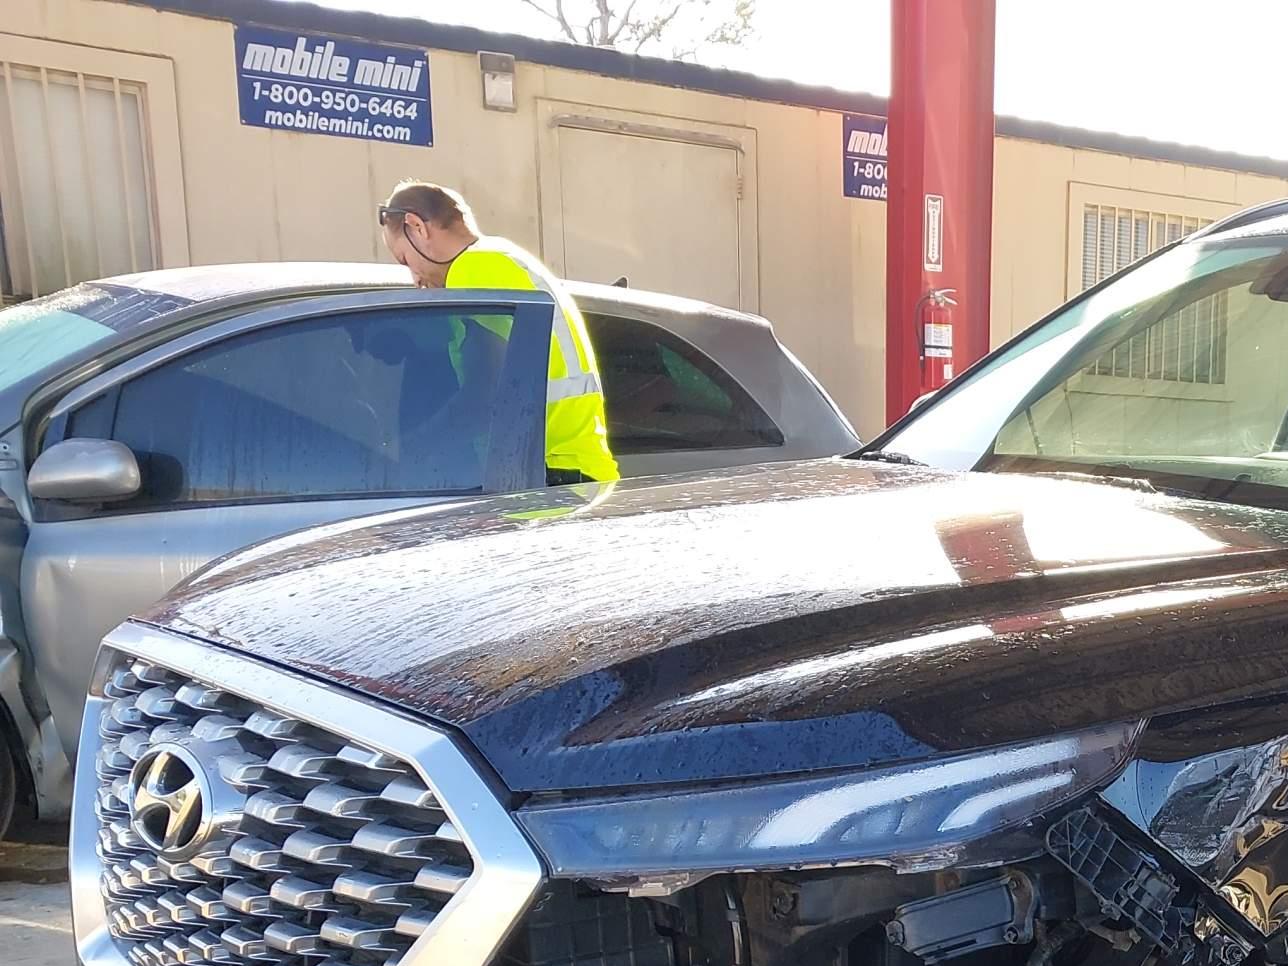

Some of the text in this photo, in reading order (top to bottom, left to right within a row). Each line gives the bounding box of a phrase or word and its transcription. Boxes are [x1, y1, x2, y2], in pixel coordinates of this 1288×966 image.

[243, 37, 422, 91] mobile mini
[252, 81, 418, 120] 1-800-950-6464
[264, 110, 411, 140] mobilemini.com
